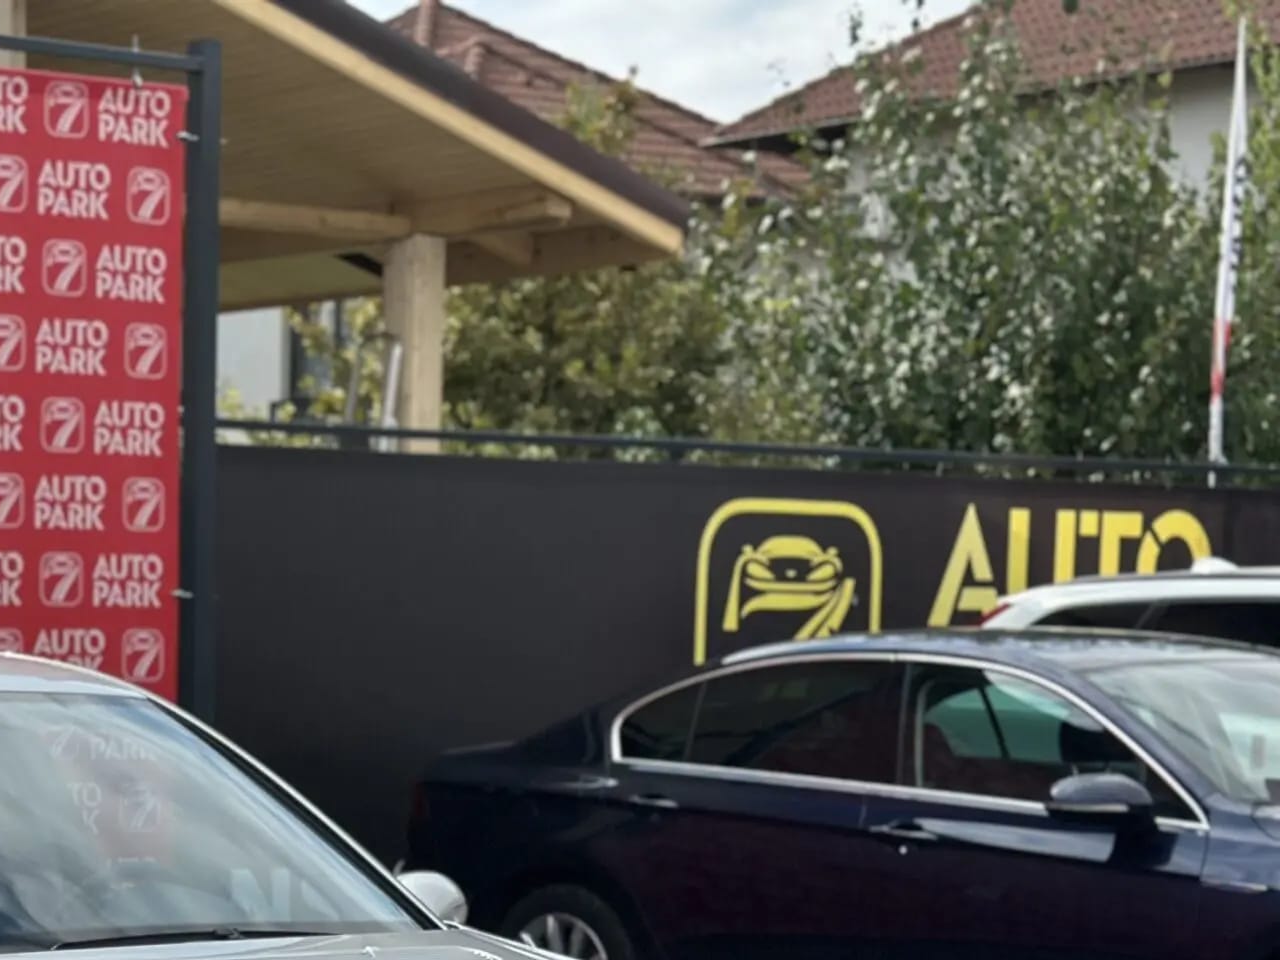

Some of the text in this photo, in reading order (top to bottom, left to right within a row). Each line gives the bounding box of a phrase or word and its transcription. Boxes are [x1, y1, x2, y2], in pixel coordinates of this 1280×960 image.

[98, 88, 171, 119] AUTO
[98, 112, 168, 148] PARK
[38, 160, 111, 191] AUTO
[37, 186, 108, 220] PARK
[96, 245, 167, 276] AUTO
[96, 270, 164, 304] PARK
[35, 318, 109, 347] AUTO
[35, 345, 106, 376] PARK
[94, 400, 165, 430] AUTO
[94, 425, 162, 456] PARK
[34, 475, 106, 503] AUTO
[34, 502, 104, 530] PARK
[93, 554, 163, 581] AUTO
[92, 580, 161, 608] PARK
[33, 628, 106, 656] AUTO
